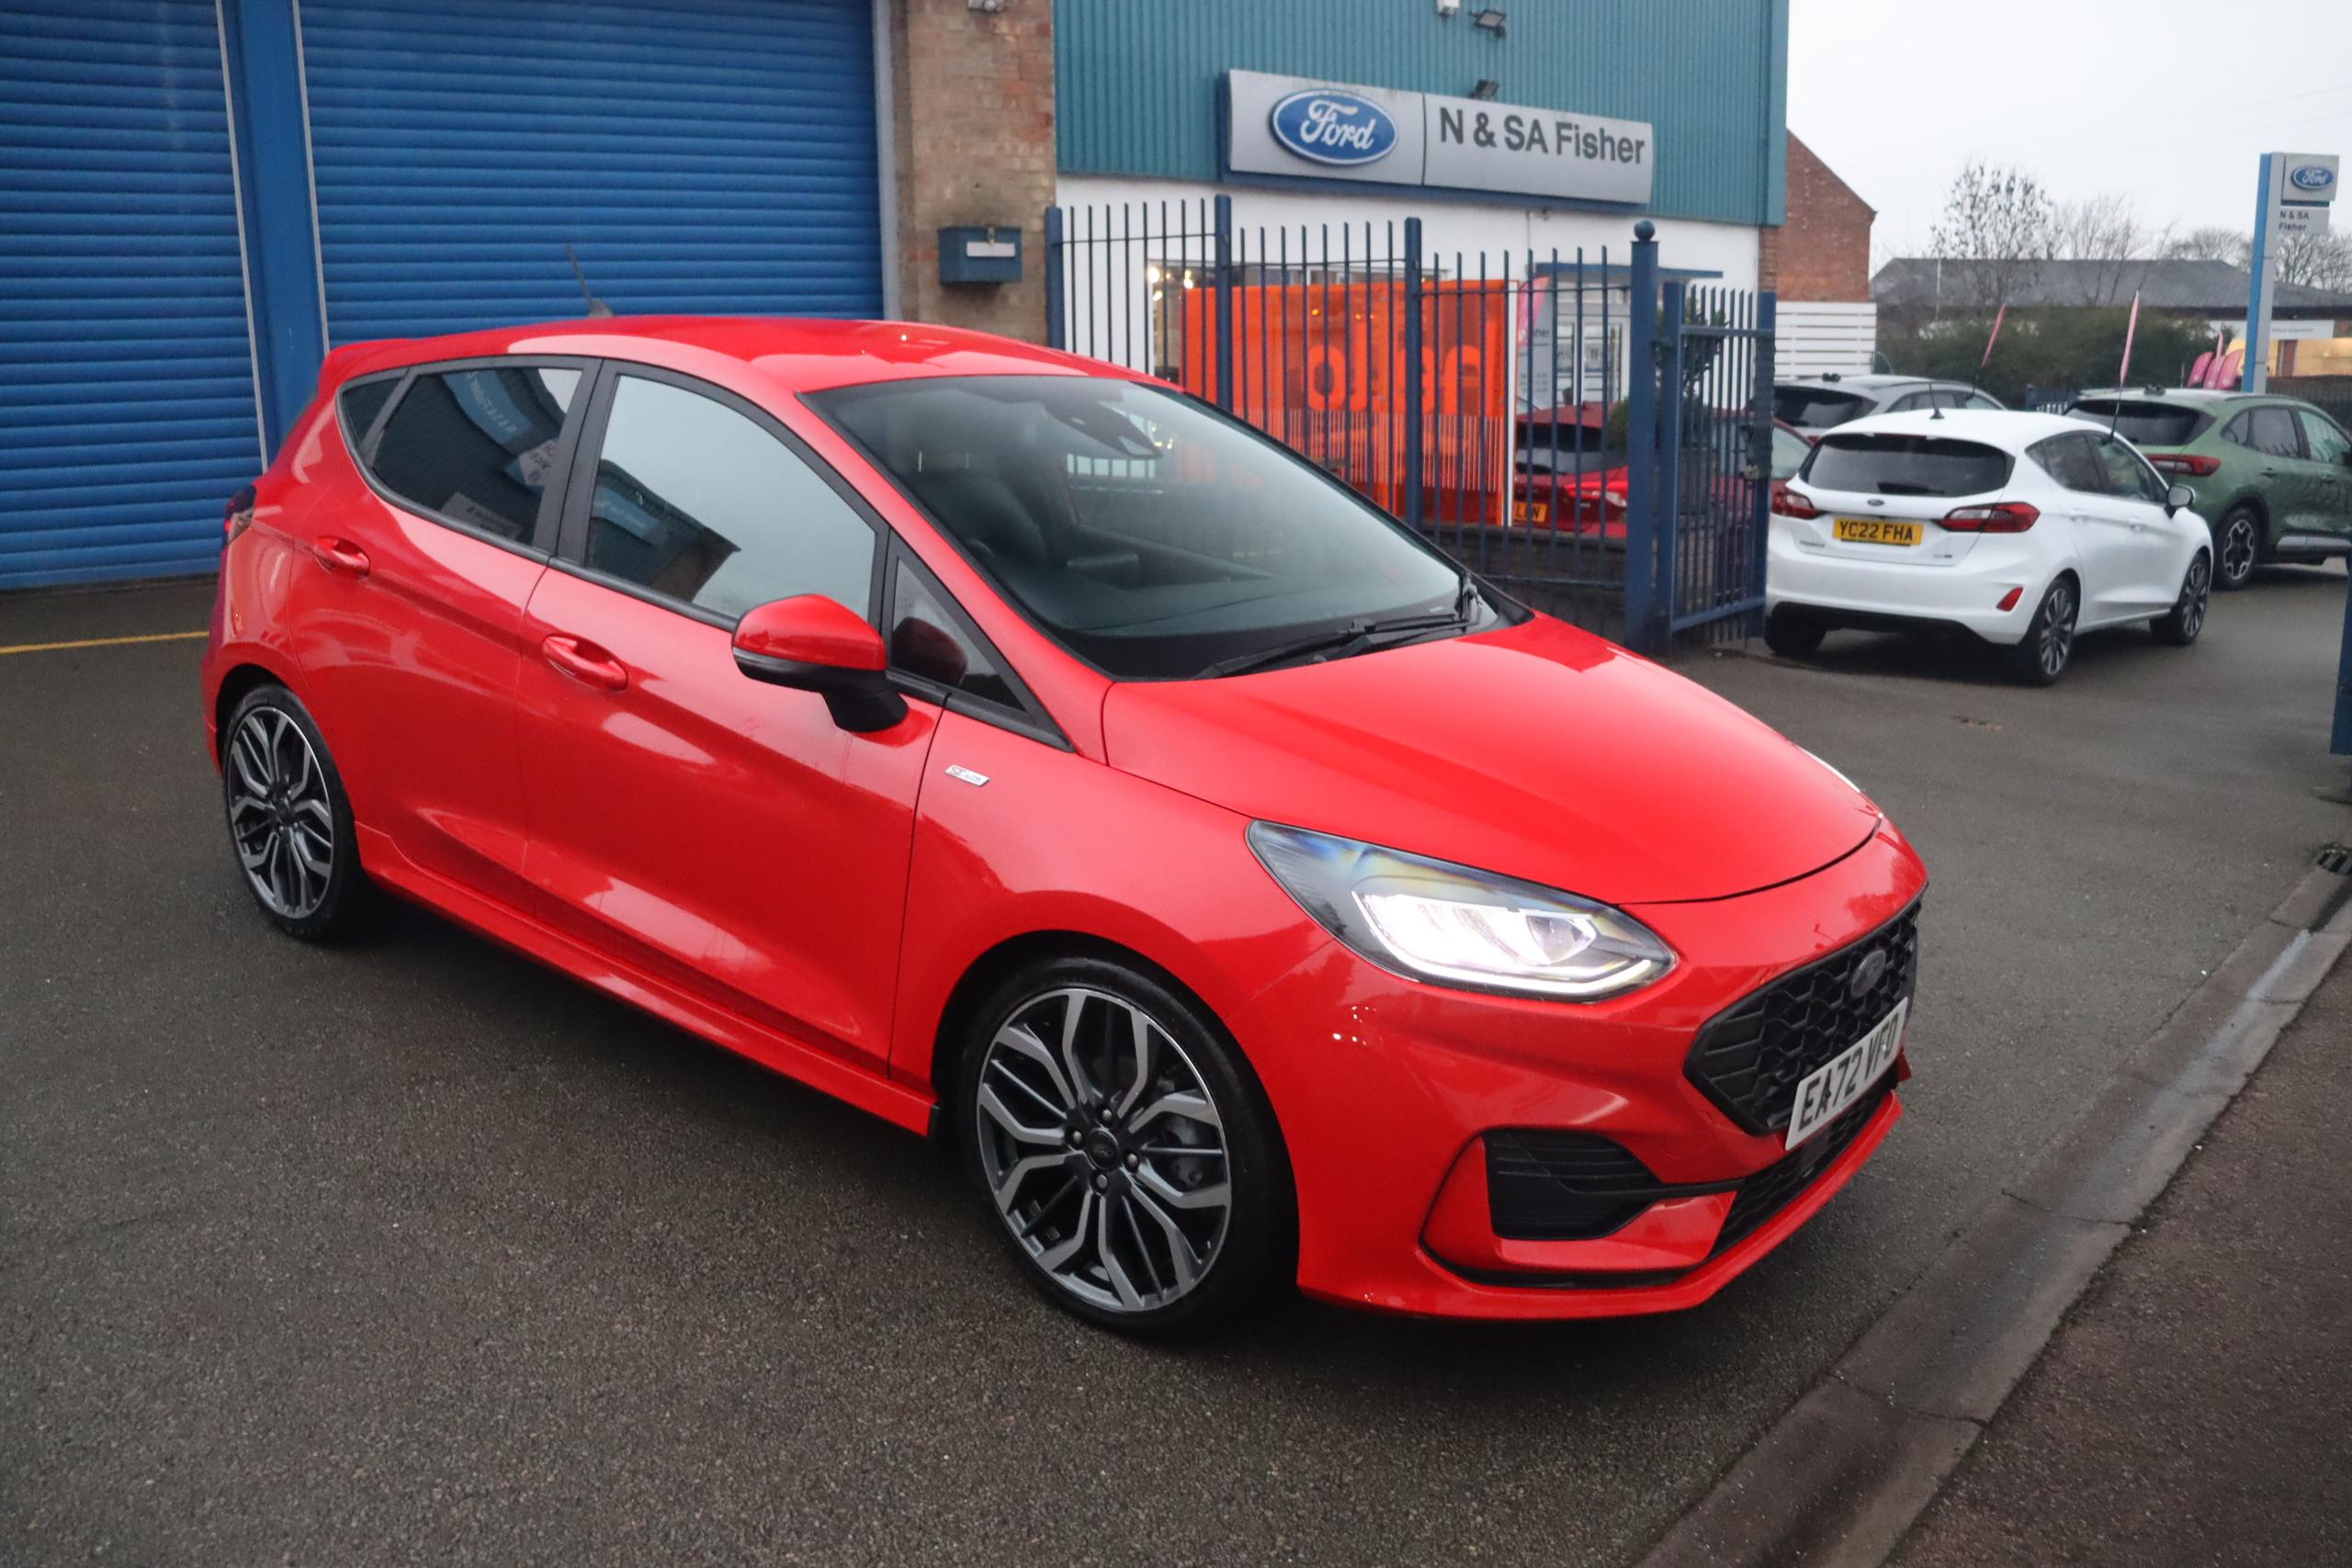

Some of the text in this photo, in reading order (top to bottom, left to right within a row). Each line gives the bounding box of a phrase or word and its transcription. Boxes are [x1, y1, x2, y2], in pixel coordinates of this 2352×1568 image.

[1300, 99, 1376, 150] Ford
[1440, 107, 1645, 164] N & SA Fisher
[2301, 168, 2328, 184] Ford
[2279, 210, 2310, 220] N & SA
[2278, 221, 2307, 231] Fisher
[1839, 521, 1913, 542] YC22 FHA
